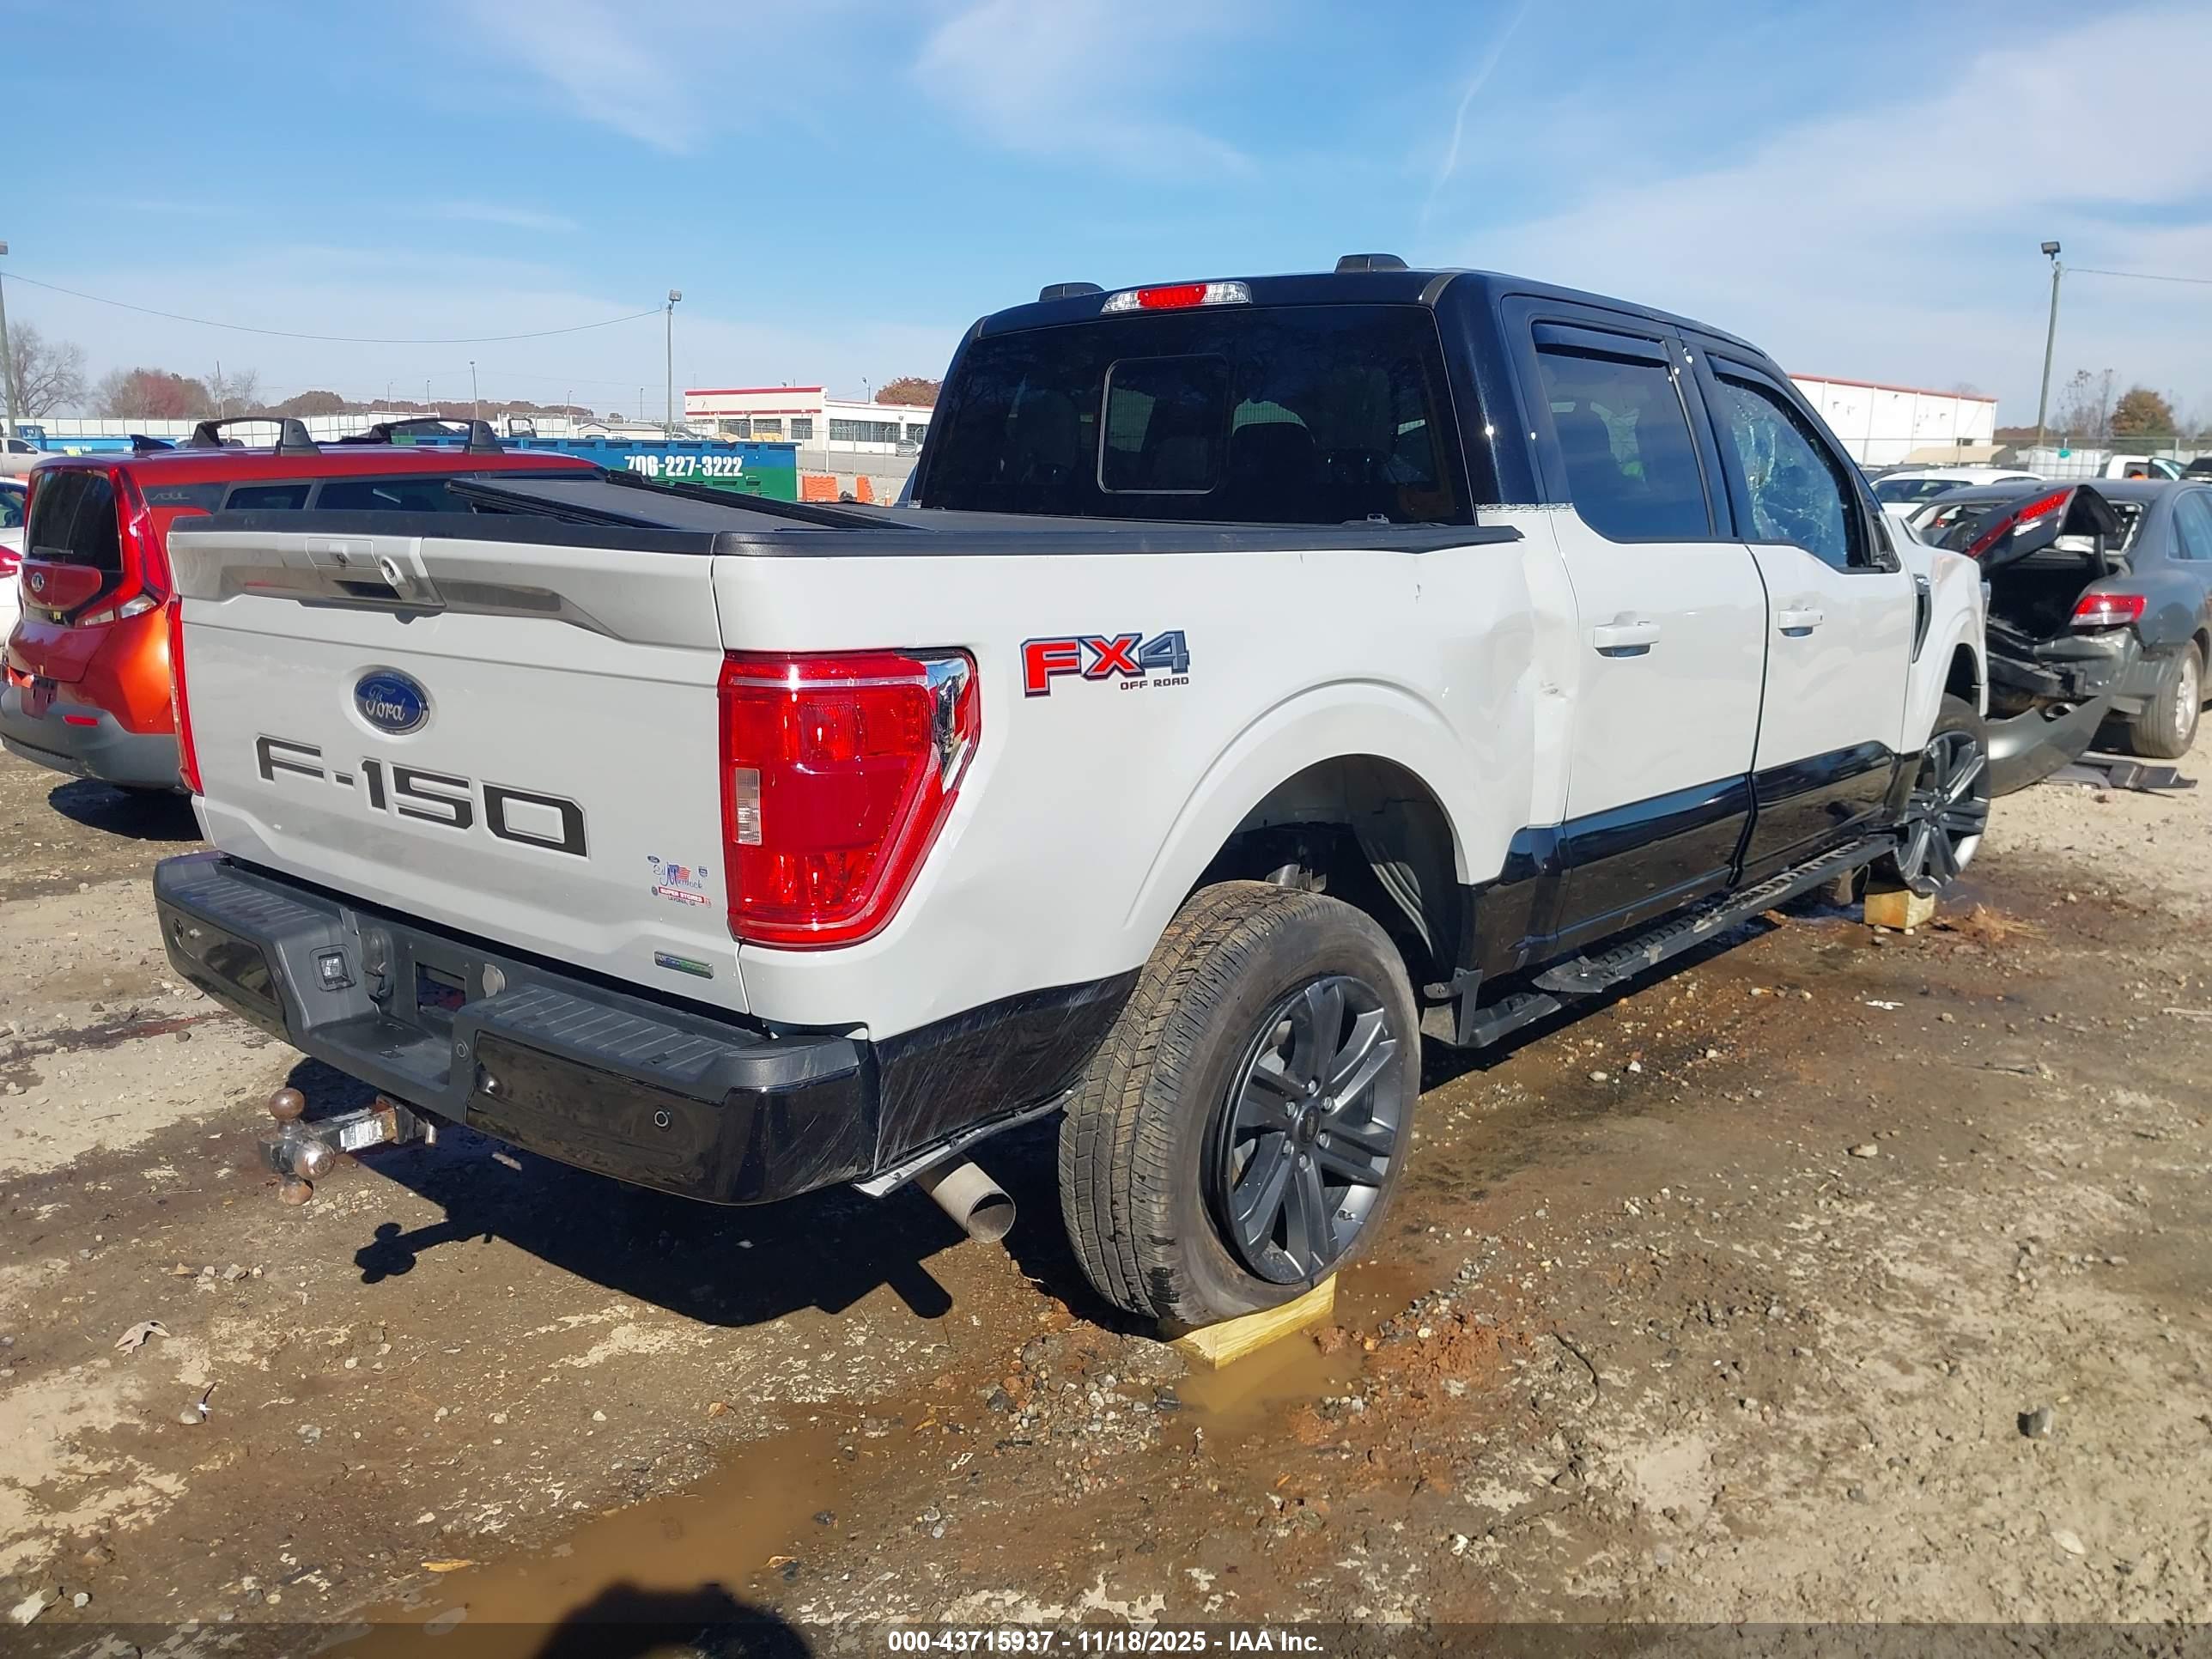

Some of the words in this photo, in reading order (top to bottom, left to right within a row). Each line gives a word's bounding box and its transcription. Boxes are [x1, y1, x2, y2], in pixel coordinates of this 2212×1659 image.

[624, 455, 743, 477] 706-227-3222
[1020, 630, 1190, 698] FX4
[1120, 679, 1148, 690] OFF
[1153, 676, 1189, 687] ROAD
[365, 684, 406, 722] Ford
[255, 733, 591, 860] F-150
